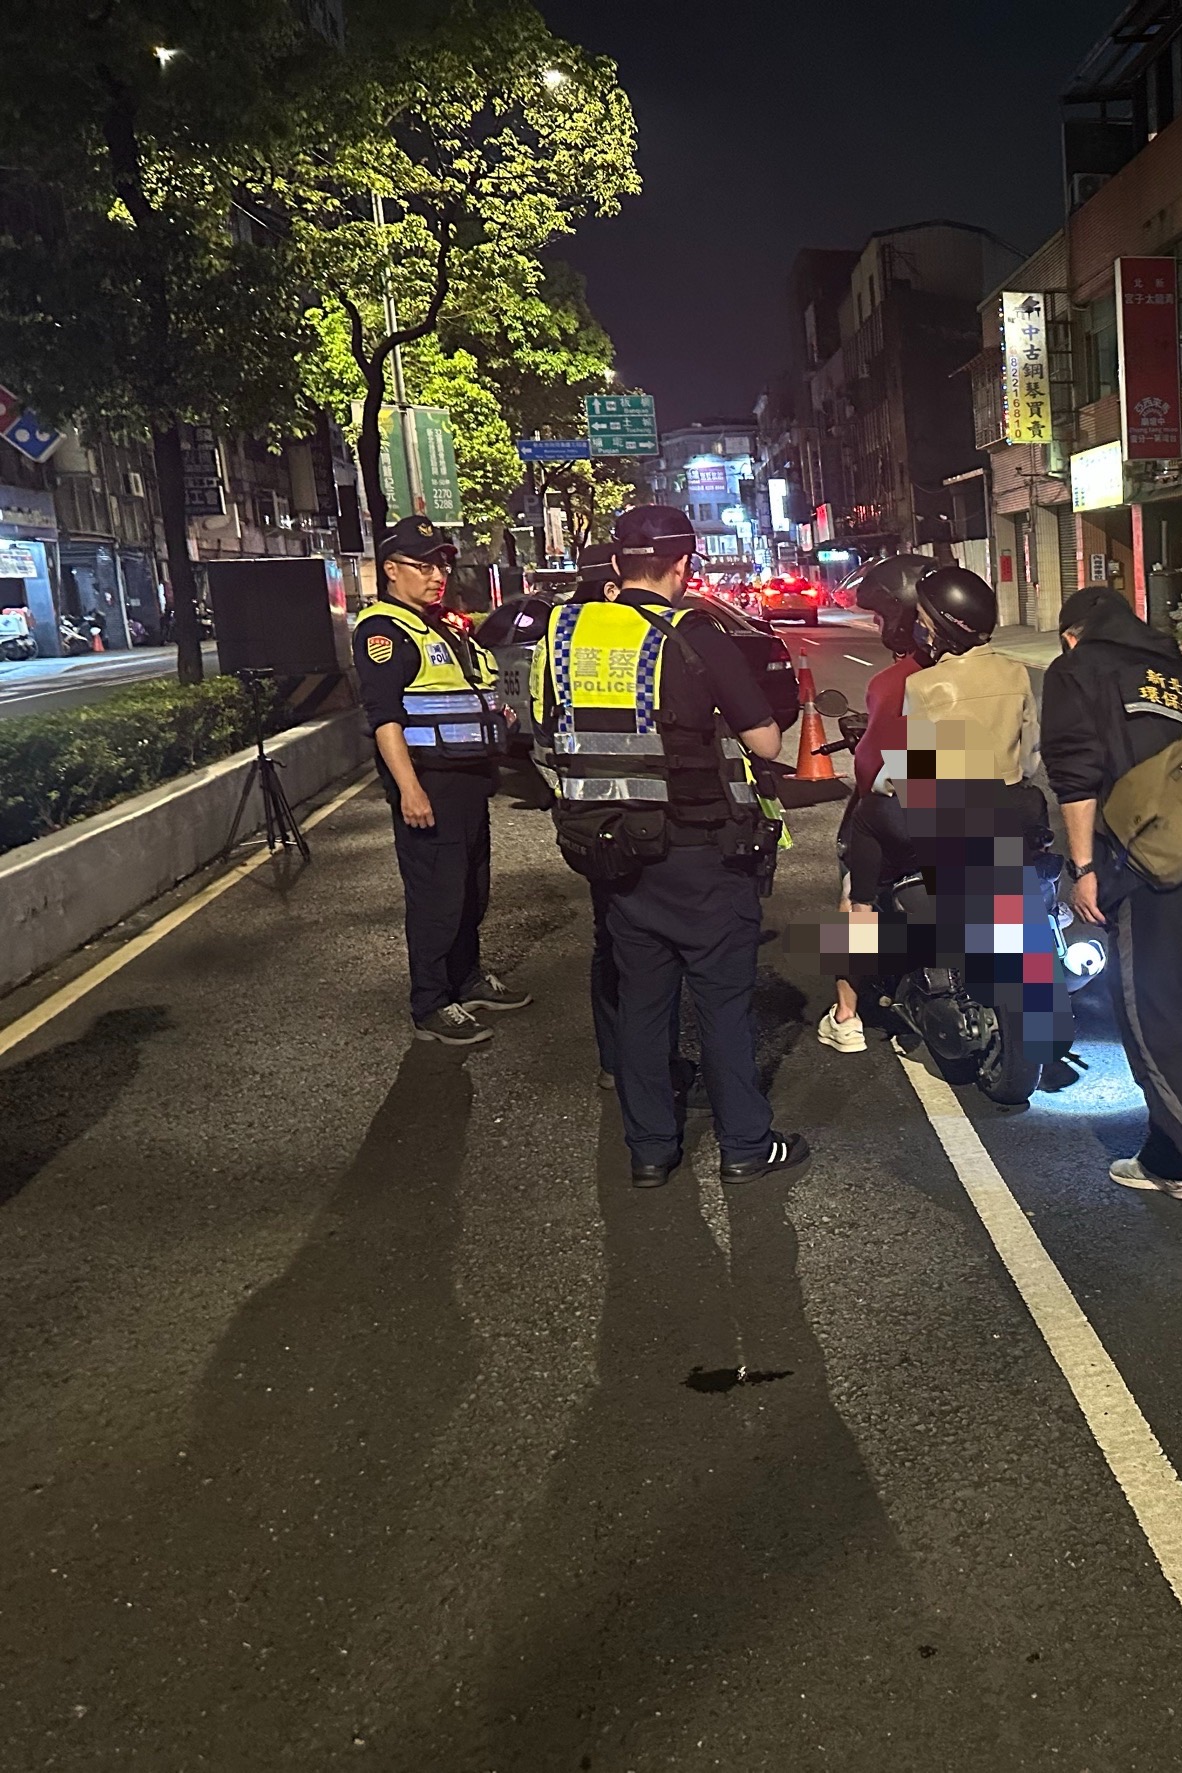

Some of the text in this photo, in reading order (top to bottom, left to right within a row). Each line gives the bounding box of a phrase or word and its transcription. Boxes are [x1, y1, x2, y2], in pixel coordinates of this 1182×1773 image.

[1021, 324, 1046, 439] 中古鋼琴買賣
[1010, 357, 1022, 438] 82216810
[433, 488, 453, 499] 2270
[434, 499, 454, 510] 5288
[573, 646, 637, 679] 警察
[504, 670, 521, 696] 565
[573, 680, 636, 693] POLICE
